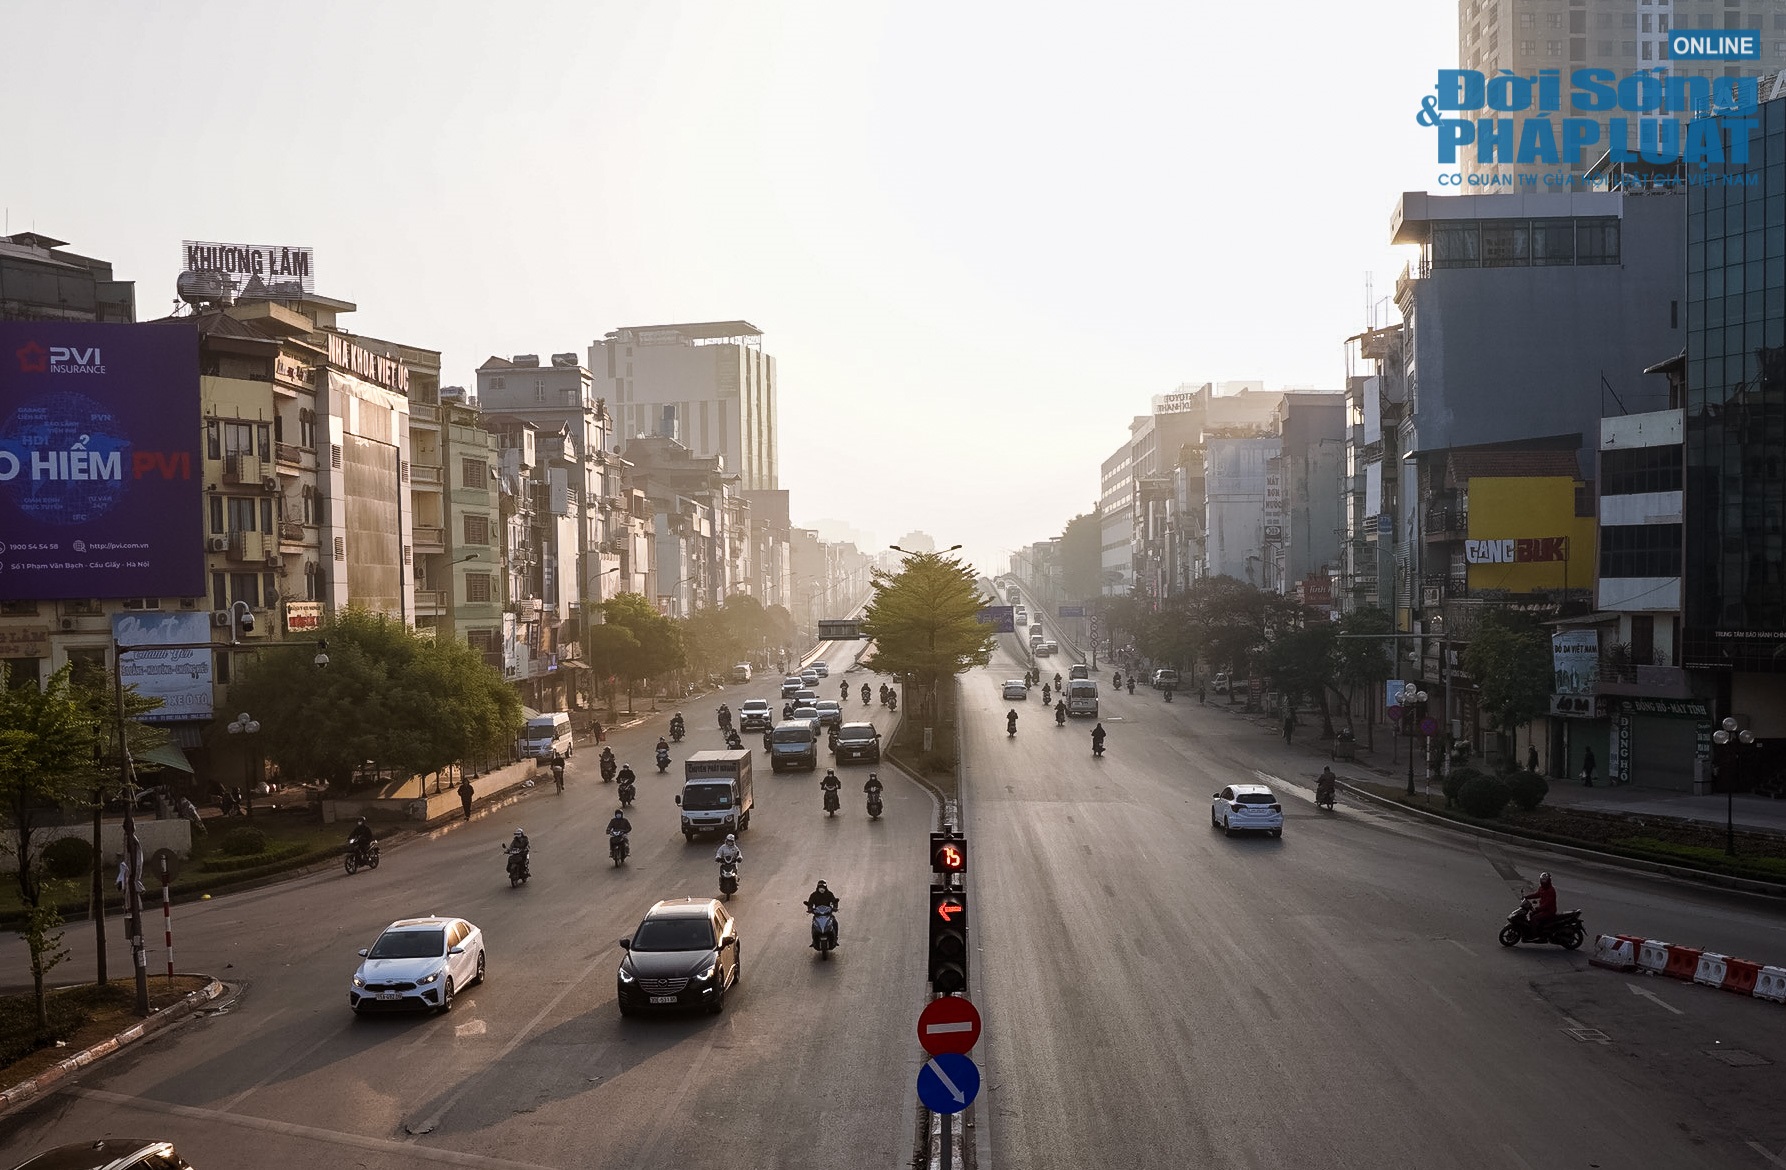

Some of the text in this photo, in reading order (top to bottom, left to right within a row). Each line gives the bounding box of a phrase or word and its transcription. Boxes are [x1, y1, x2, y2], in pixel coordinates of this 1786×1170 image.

[187, 245, 309, 276] KHƯƠNG LÂM
[50, 347, 100, 365] PVI
[327, 333, 349, 369] NHA
[350, 343, 376, 381] KHOA
[376, 351, 396, 389] VIỆT
[397, 357, 409, 393] ÚC
[50, 365, 106, 374] INSURANCE
[31, 434, 122, 480] HIỂM
[132, 452, 191, 480] PVI
[89, 542, 149, 551] http://pvi.com.vn
[1464, 539, 1515, 564] GANG
[1733, 630, 1745, 638] TÂM
[1563, 644, 1570, 653] DA
[1572, 642, 1584, 654] VIỆT
[1585, 644, 1598, 654] NAM
[1635, 697, 1656, 712] ĐỒNG
[1670, 700, 1687, 714] MÁY
[1687, 702, 1707, 715] TÍNH
[1620, 717, 1629, 757] ĐỒNG
